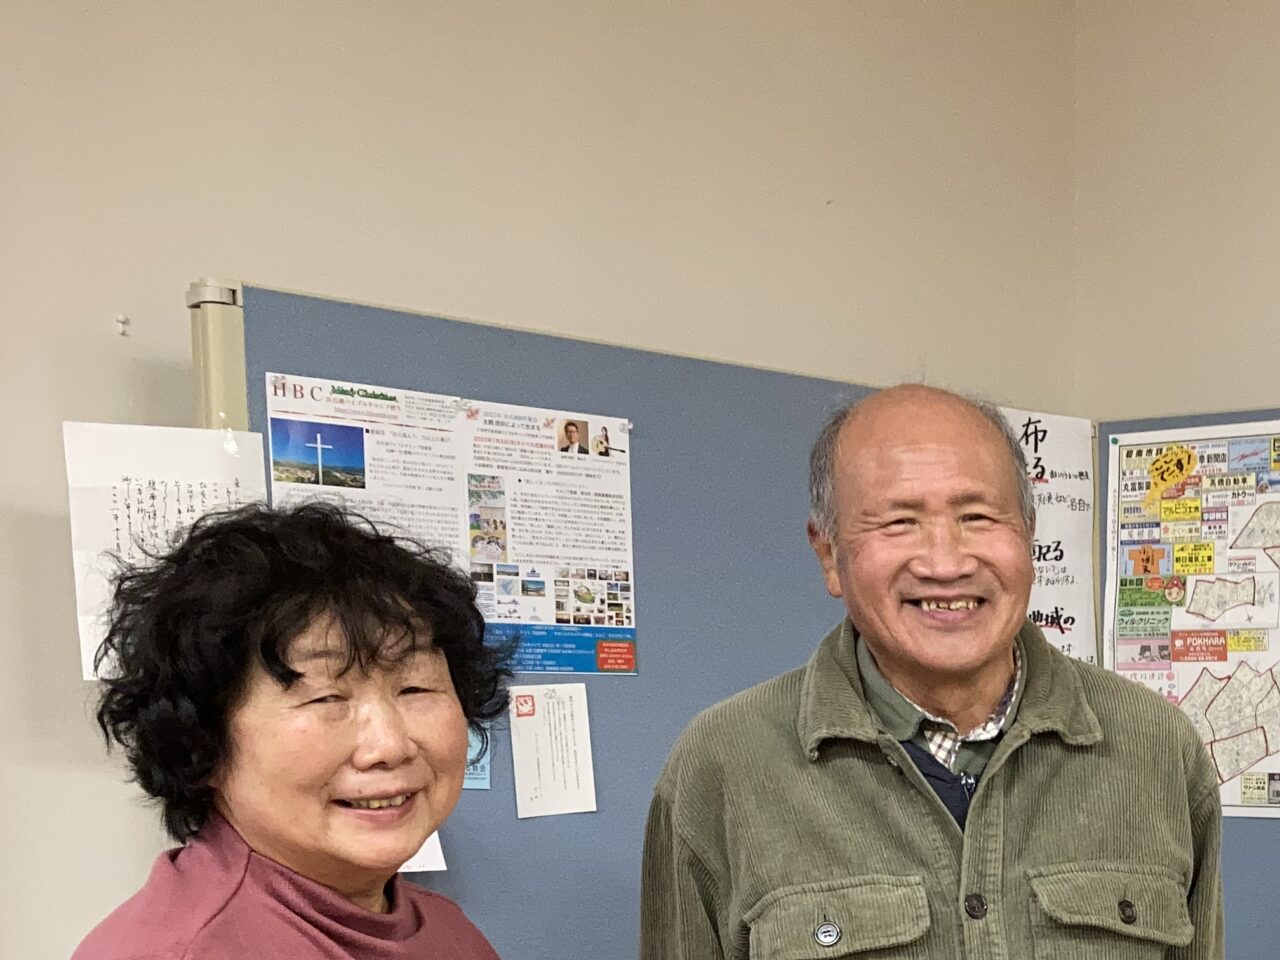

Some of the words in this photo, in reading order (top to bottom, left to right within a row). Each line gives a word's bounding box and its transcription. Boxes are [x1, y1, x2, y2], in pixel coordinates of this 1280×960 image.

[1018, 416, 1048, 454] 布
[1117, 617, 1169, 626] ウィルクリニック
[1186, 637, 1226, 647] POKHARA
